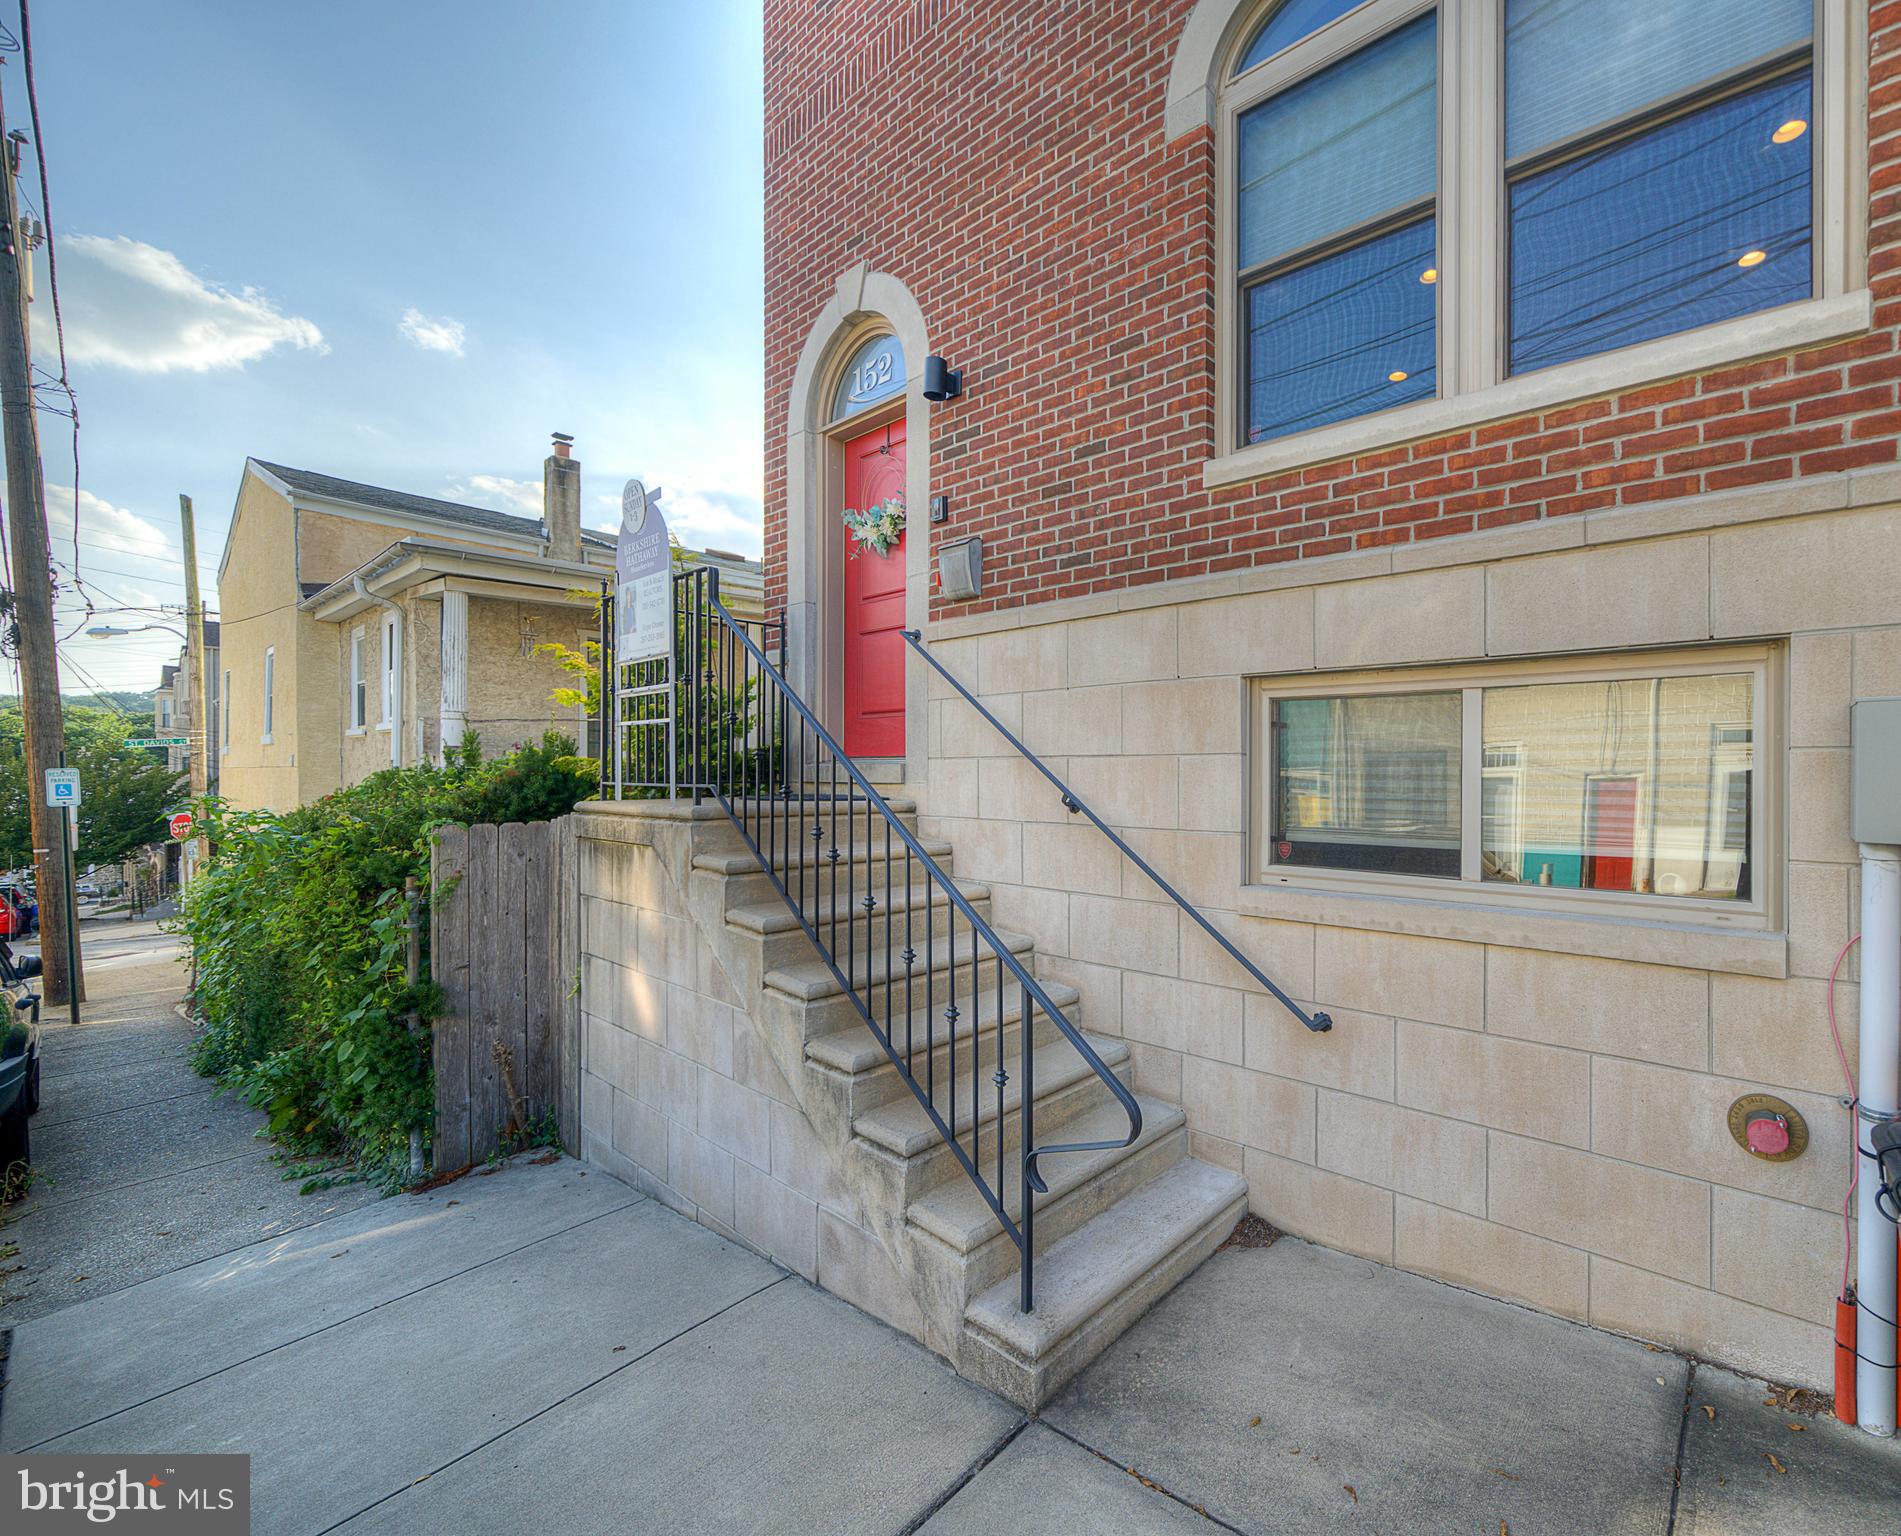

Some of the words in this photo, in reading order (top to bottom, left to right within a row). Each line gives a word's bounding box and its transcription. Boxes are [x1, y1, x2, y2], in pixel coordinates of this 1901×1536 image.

[853, 352, 893, 397] 152
[624, 483, 639, 500] OPEN
[624, 495, 643, 513] SUNDAY
[623, 532, 660, 556] BERKSHIRE
[626, 546, 659, 567] HATHAWAY
